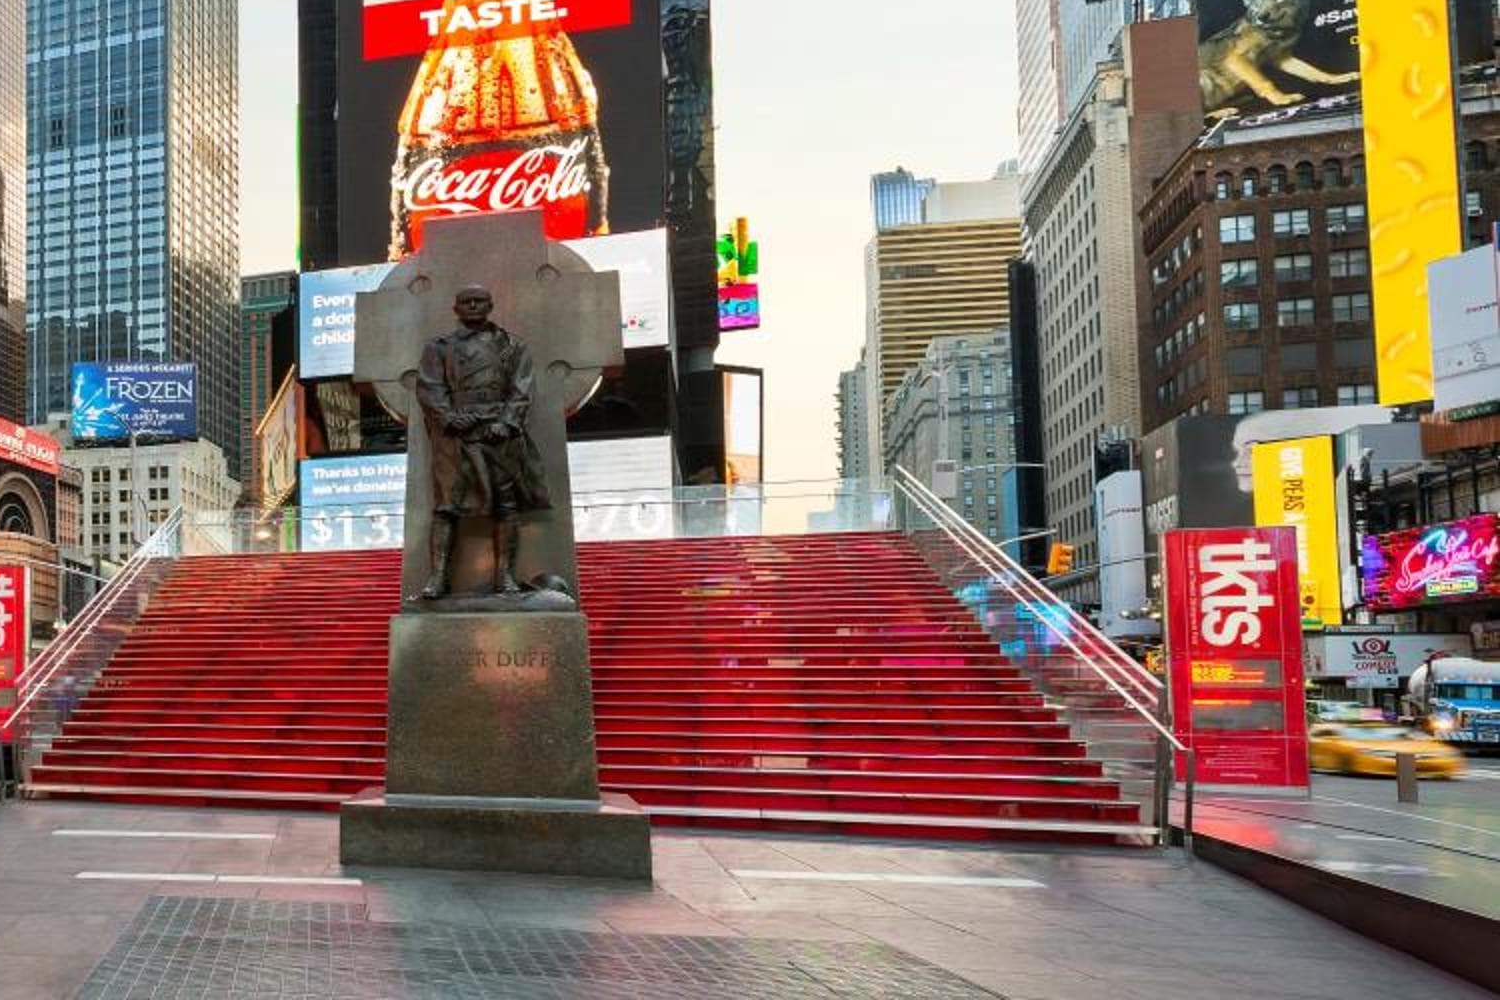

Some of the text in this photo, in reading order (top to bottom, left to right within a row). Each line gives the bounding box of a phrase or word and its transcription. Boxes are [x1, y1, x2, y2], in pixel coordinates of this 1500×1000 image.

[105, 377, 194, 403] FROZEN
[312, 467, 358, 480] Thanks
[1283, 479, 1305, 511] PEAS
[1199, 537, 1277, 647] tkts
